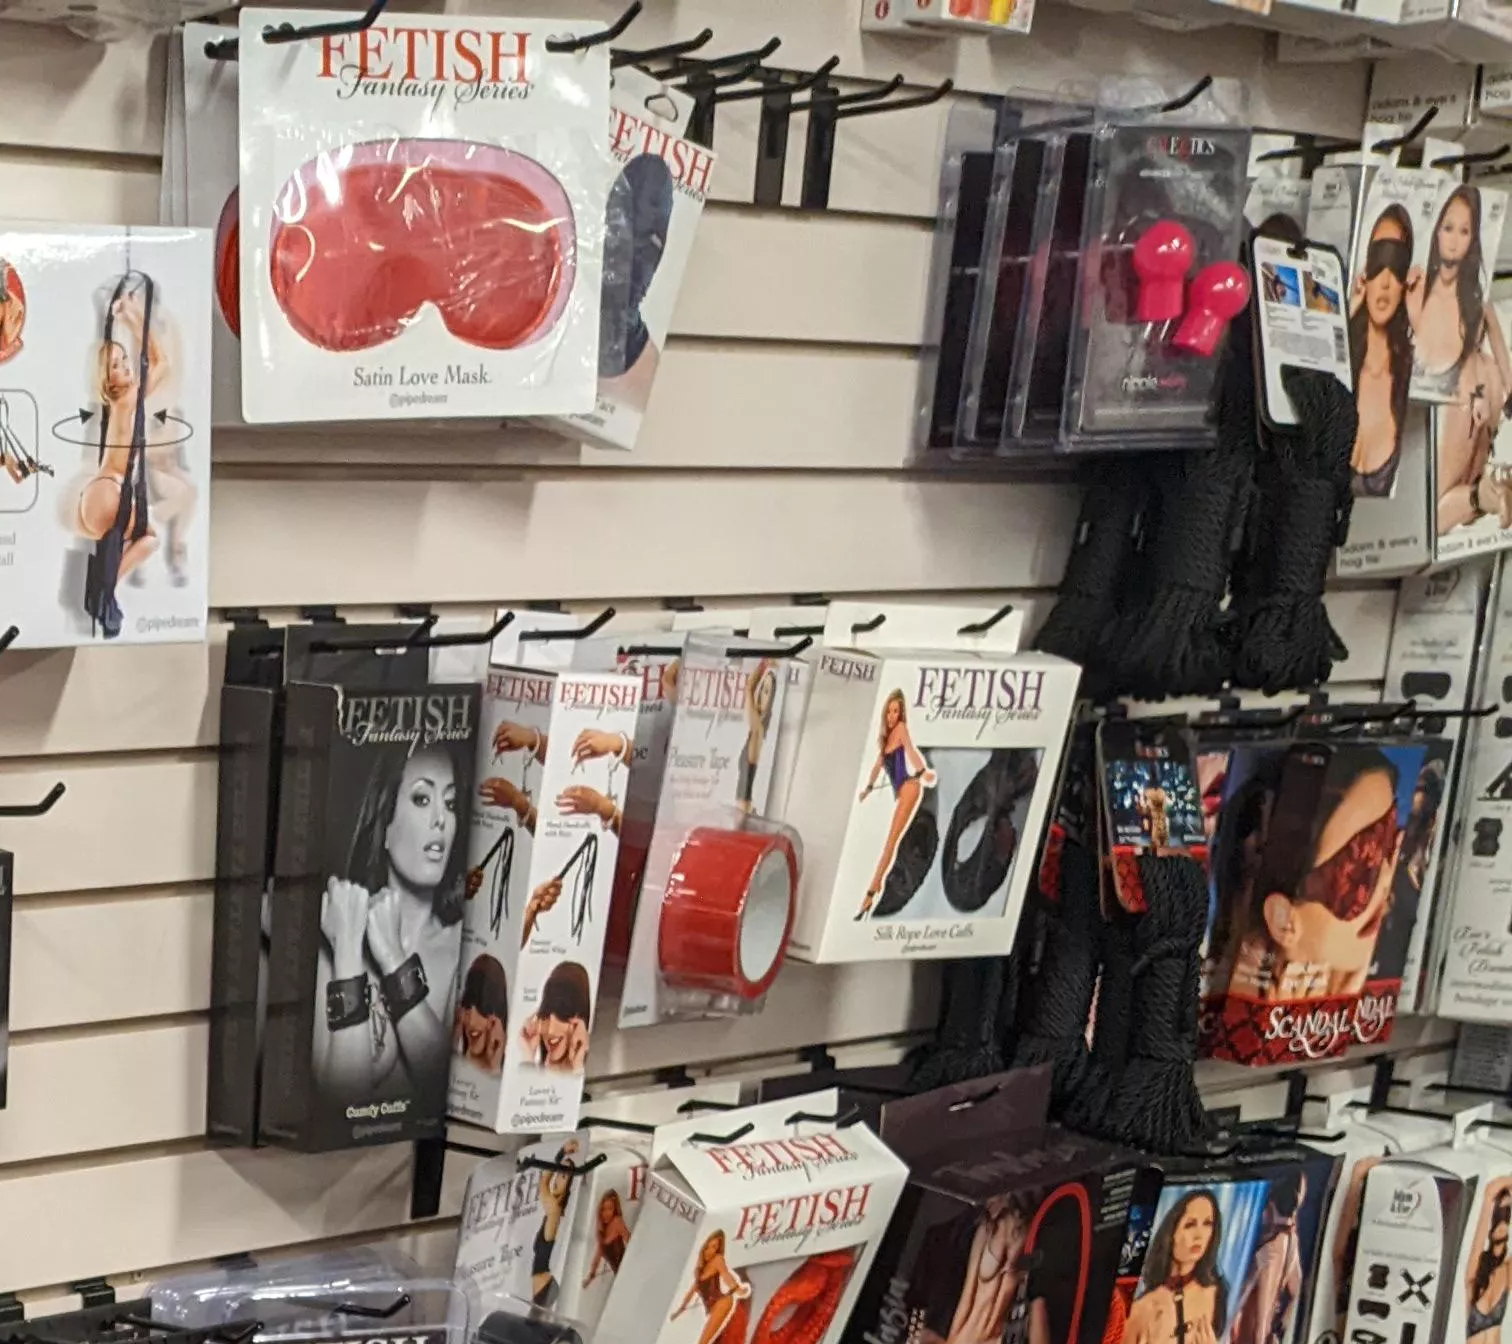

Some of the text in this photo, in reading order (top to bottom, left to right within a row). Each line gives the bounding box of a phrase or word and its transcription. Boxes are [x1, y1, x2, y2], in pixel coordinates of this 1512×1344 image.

[317, 27, 532, 86] FETISH
[336, 62, 444, 112] Fantasy
[352, 364, 439, 388] Satin Love
[820, 656, 876, 682] FETISH
[914, 667, 1046, 711] FETISH
[347, 695, 472, 731] FETISH
[560, 682, 638, 706] FETISH
[350, 721, 423, 759] Fantasy
[924, 923, 946, 940] Love
[1265, 1005, 1350, 1059] SCANDAL
[705, 1133, 854, 1175] FETISH
[733, 1185, 871, 1242] FETISH
